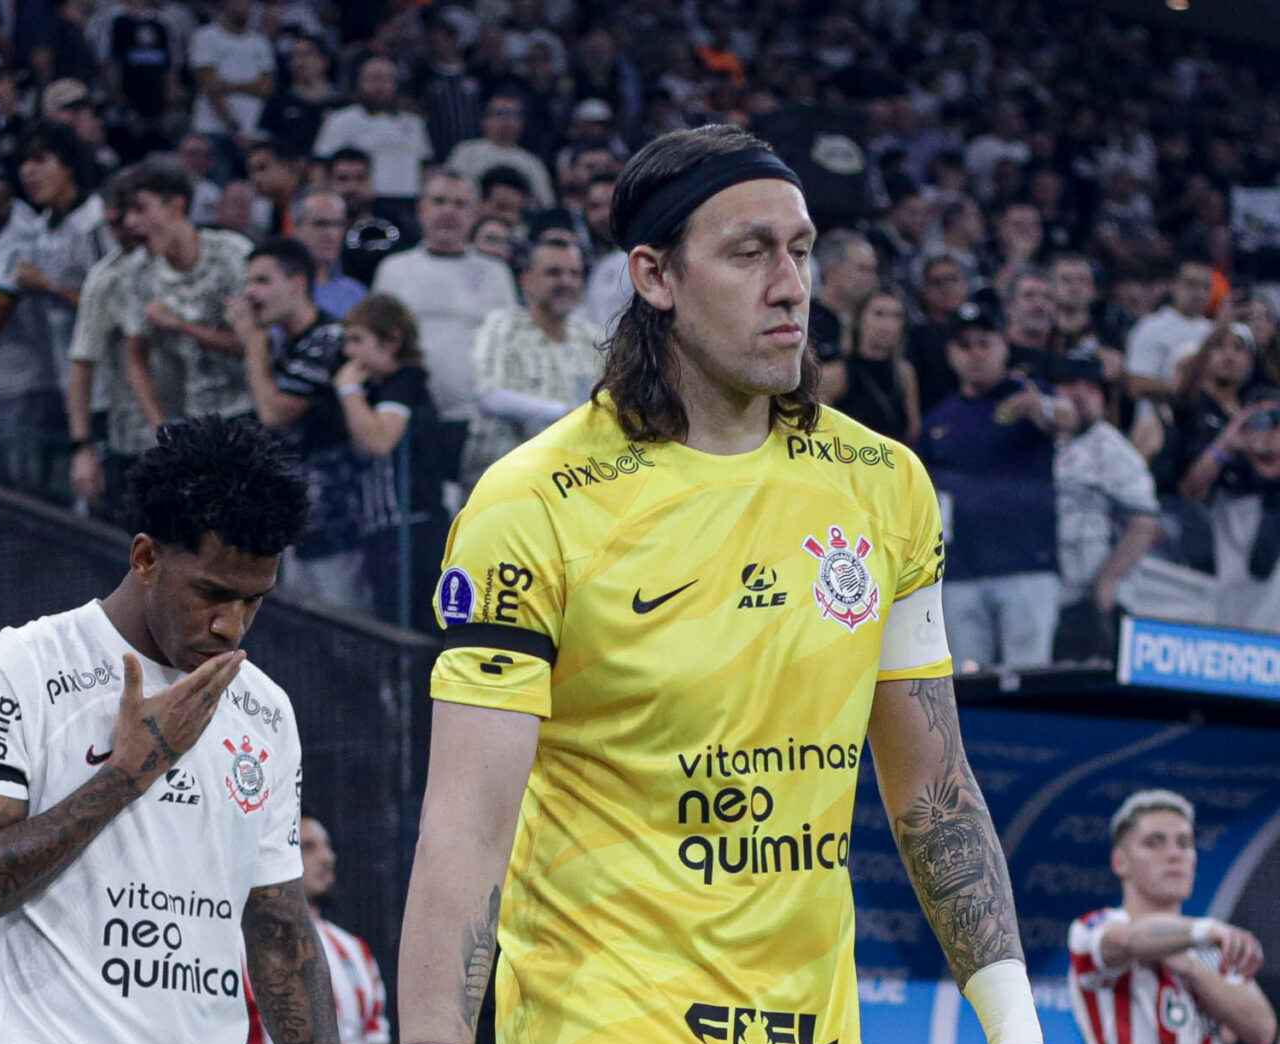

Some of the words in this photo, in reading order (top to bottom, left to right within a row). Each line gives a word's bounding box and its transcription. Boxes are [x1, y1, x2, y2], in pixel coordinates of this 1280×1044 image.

[551, 442, 656, 498] pixbet
[787, 434, 895, 470] pixbet
[482, 568, 495, 623] ORINTHIANS
[495, 562, 534, 623] mg
[737, 590, 787, 609] ALE
[46, 659, 121, 704] pixbet
[677, 737, 858, 778] vitaminas
[158, 791, 200, 805] ALE
[678, 785, 774, 825] neo
[678, 823, 851, 886] química
[104, 917, 182, 950] neo
[101, 953, 239, 998] química
